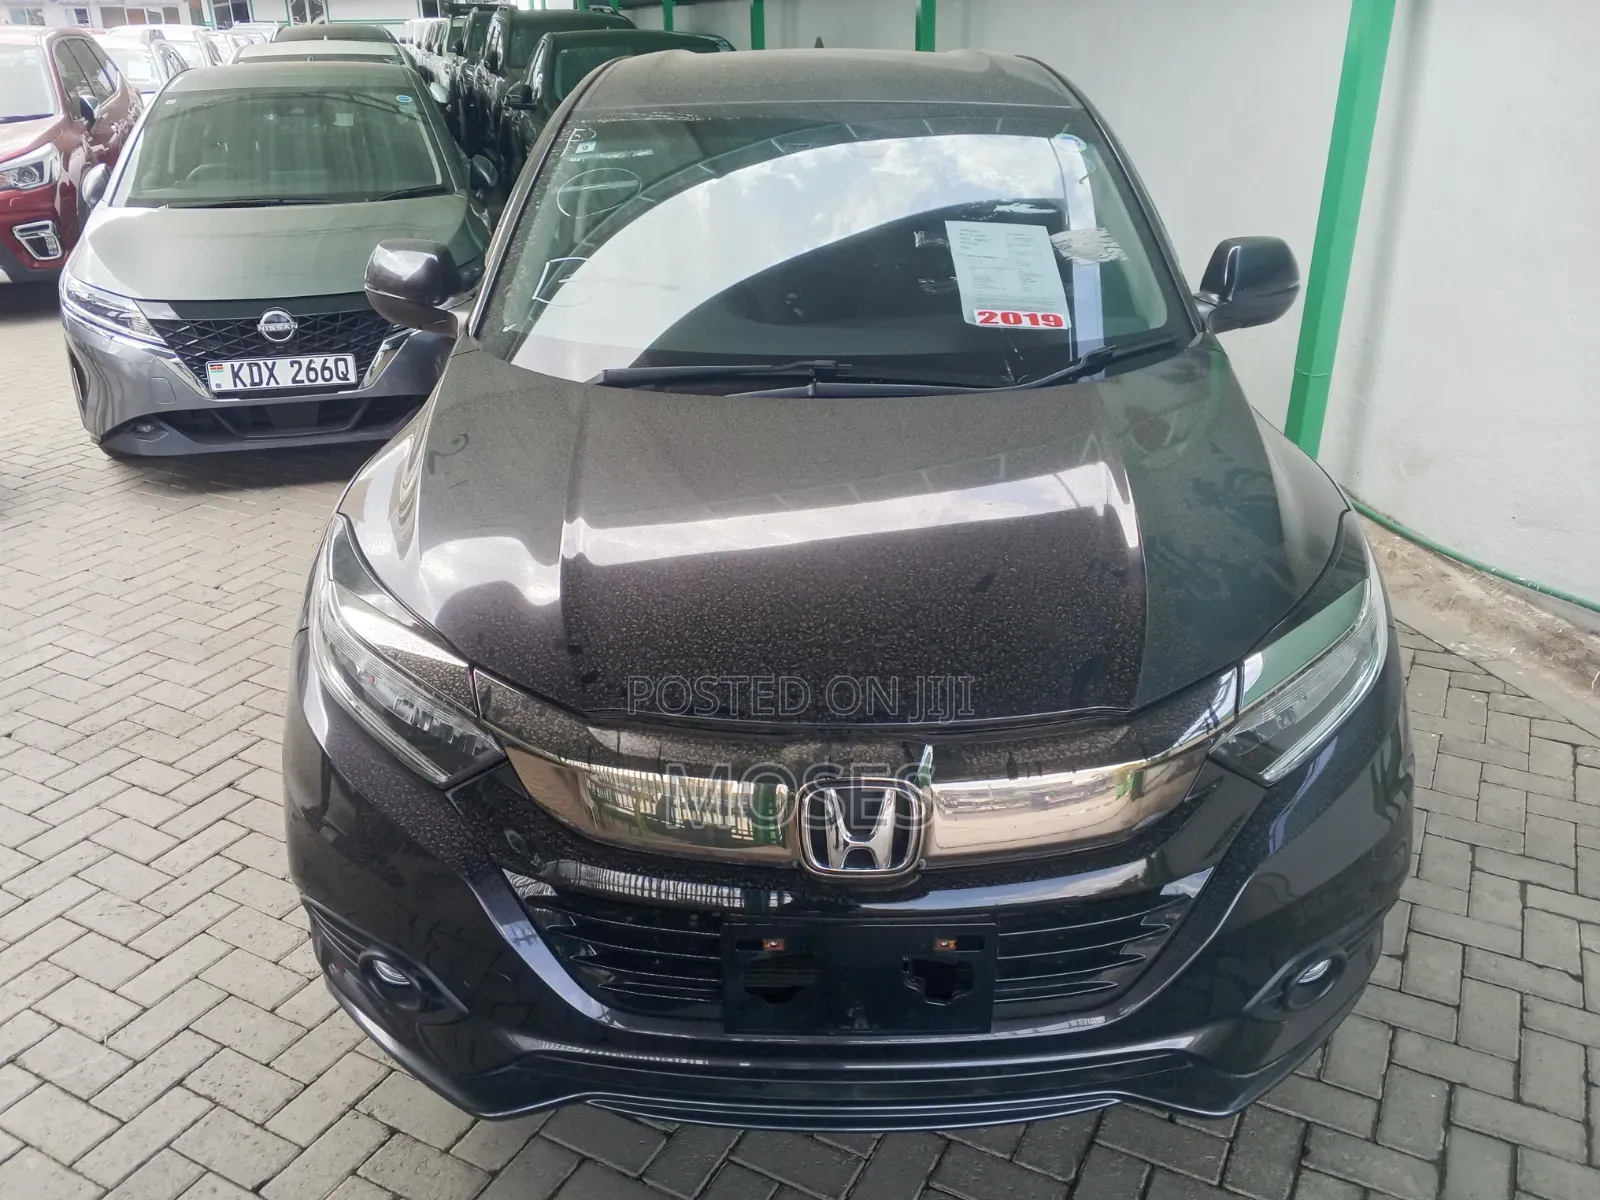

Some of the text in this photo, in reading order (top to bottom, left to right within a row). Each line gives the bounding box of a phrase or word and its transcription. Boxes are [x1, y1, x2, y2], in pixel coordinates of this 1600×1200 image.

[257, 322, 298, 332] NISSAN
[977, 311, 1063, 327] 2019
[230, 357, 350, 388] KDX 266Q
